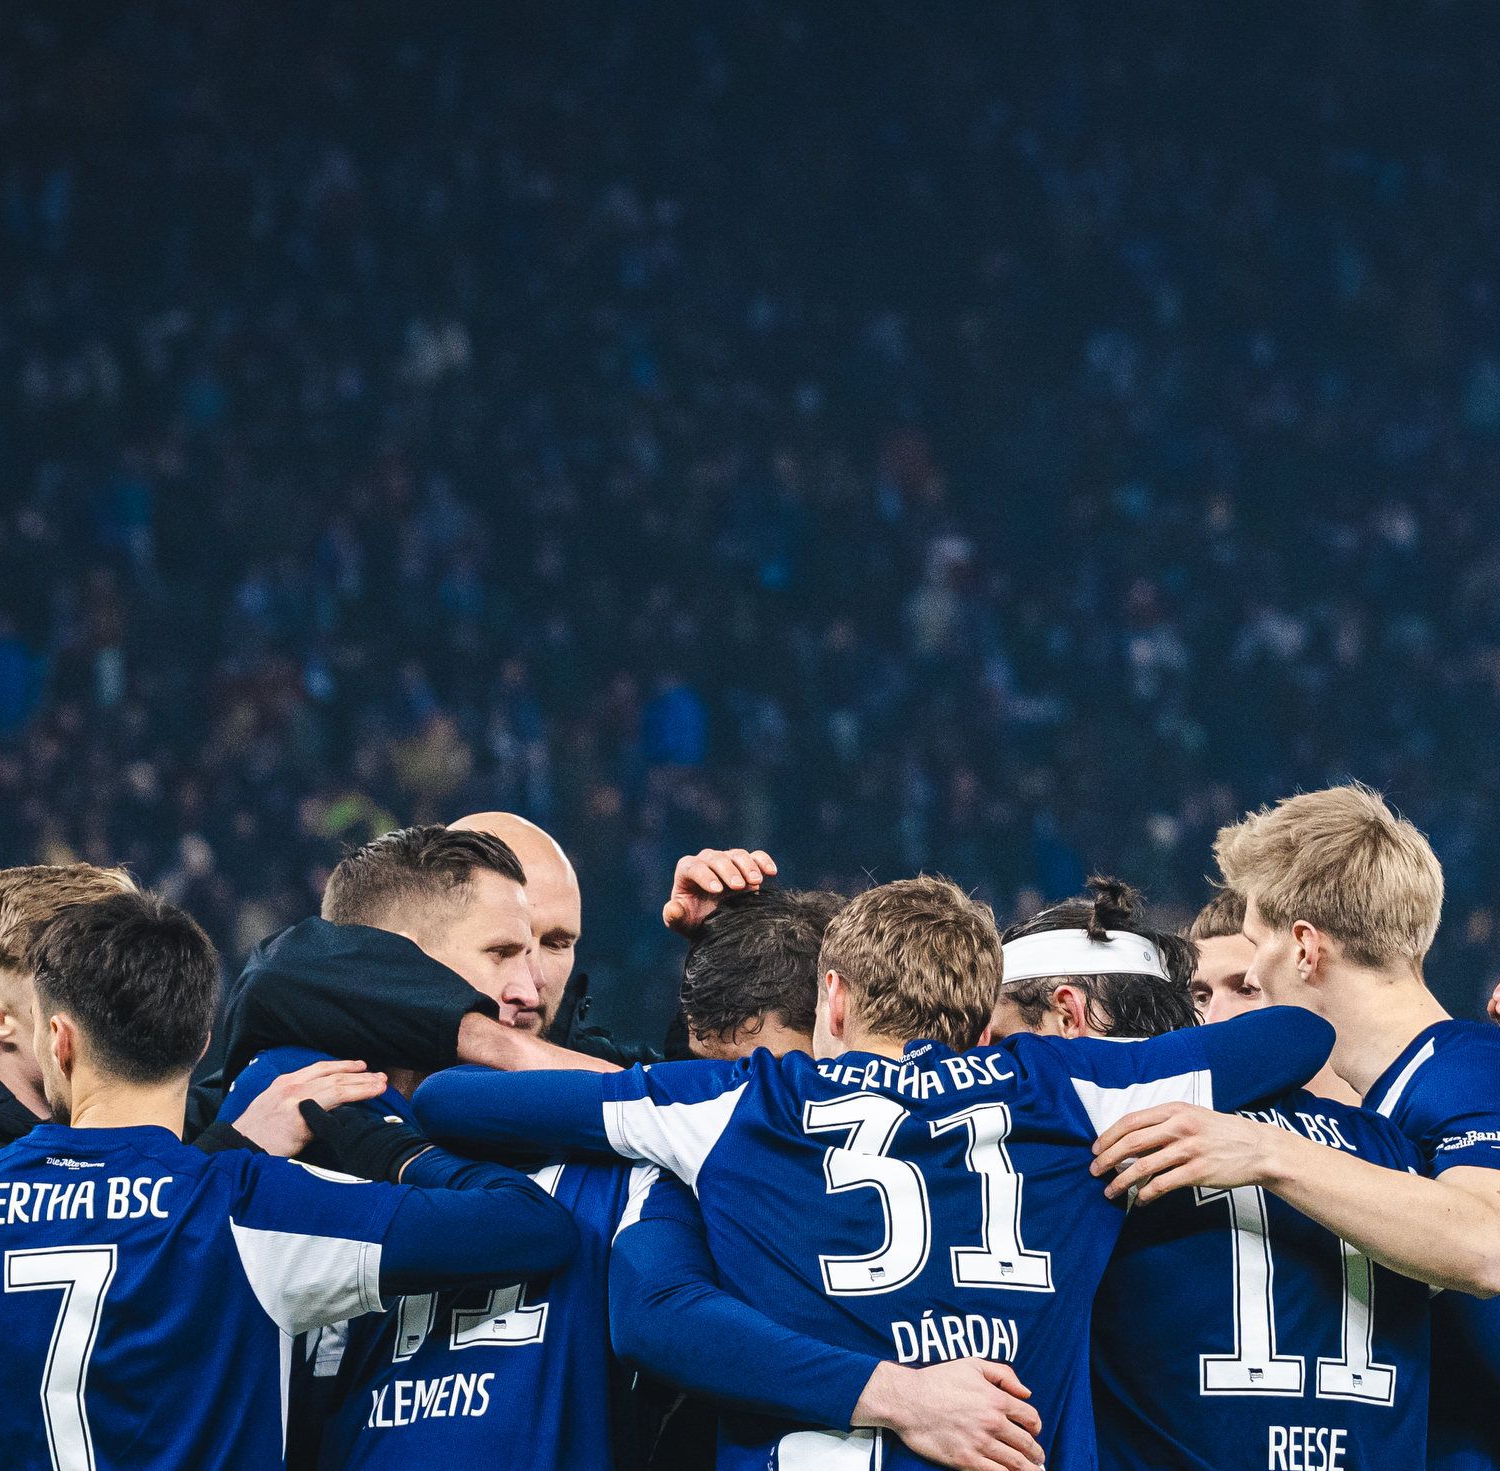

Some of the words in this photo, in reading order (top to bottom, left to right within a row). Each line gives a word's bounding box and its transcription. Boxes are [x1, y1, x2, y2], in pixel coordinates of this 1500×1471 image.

[940, 1053, 1014, 1090] BSC
[1295, 1112, 1358, 1151] BSC
[106, 1176, 174, 1220] BSC
[803, 1091, 1056, 1296] 31
[1193, 1185, 1397, 1407] 11
[891, 1309, 1019, 1363] DÁRDAI
